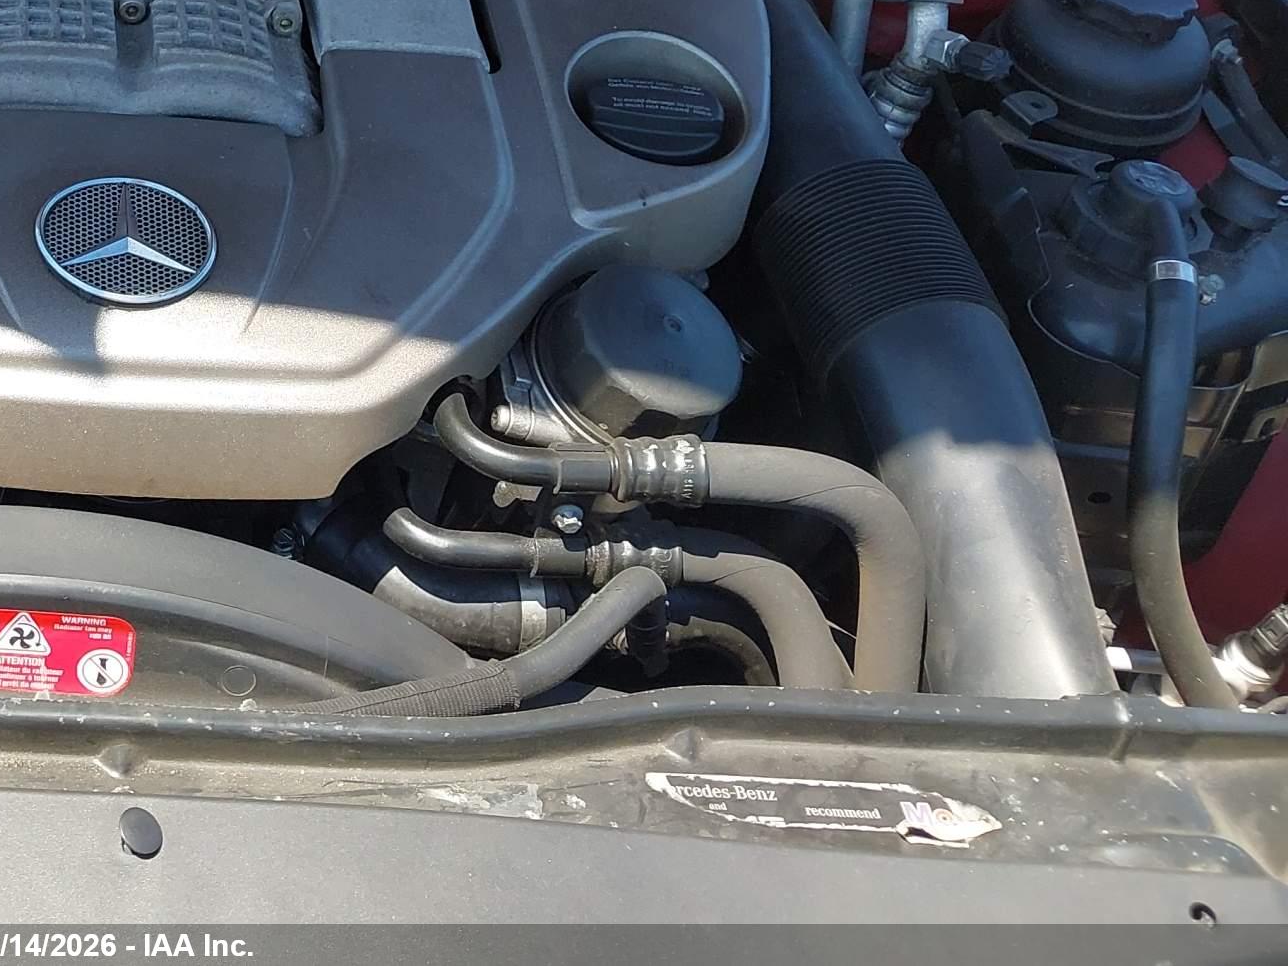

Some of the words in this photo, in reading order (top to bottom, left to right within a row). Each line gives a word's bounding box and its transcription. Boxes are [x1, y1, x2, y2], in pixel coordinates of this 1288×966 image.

[61, 615, 107, 627] WARNING
[670, 784, 778, 801] rcedes-Benz
[804, 806, 882, 819] recommend
